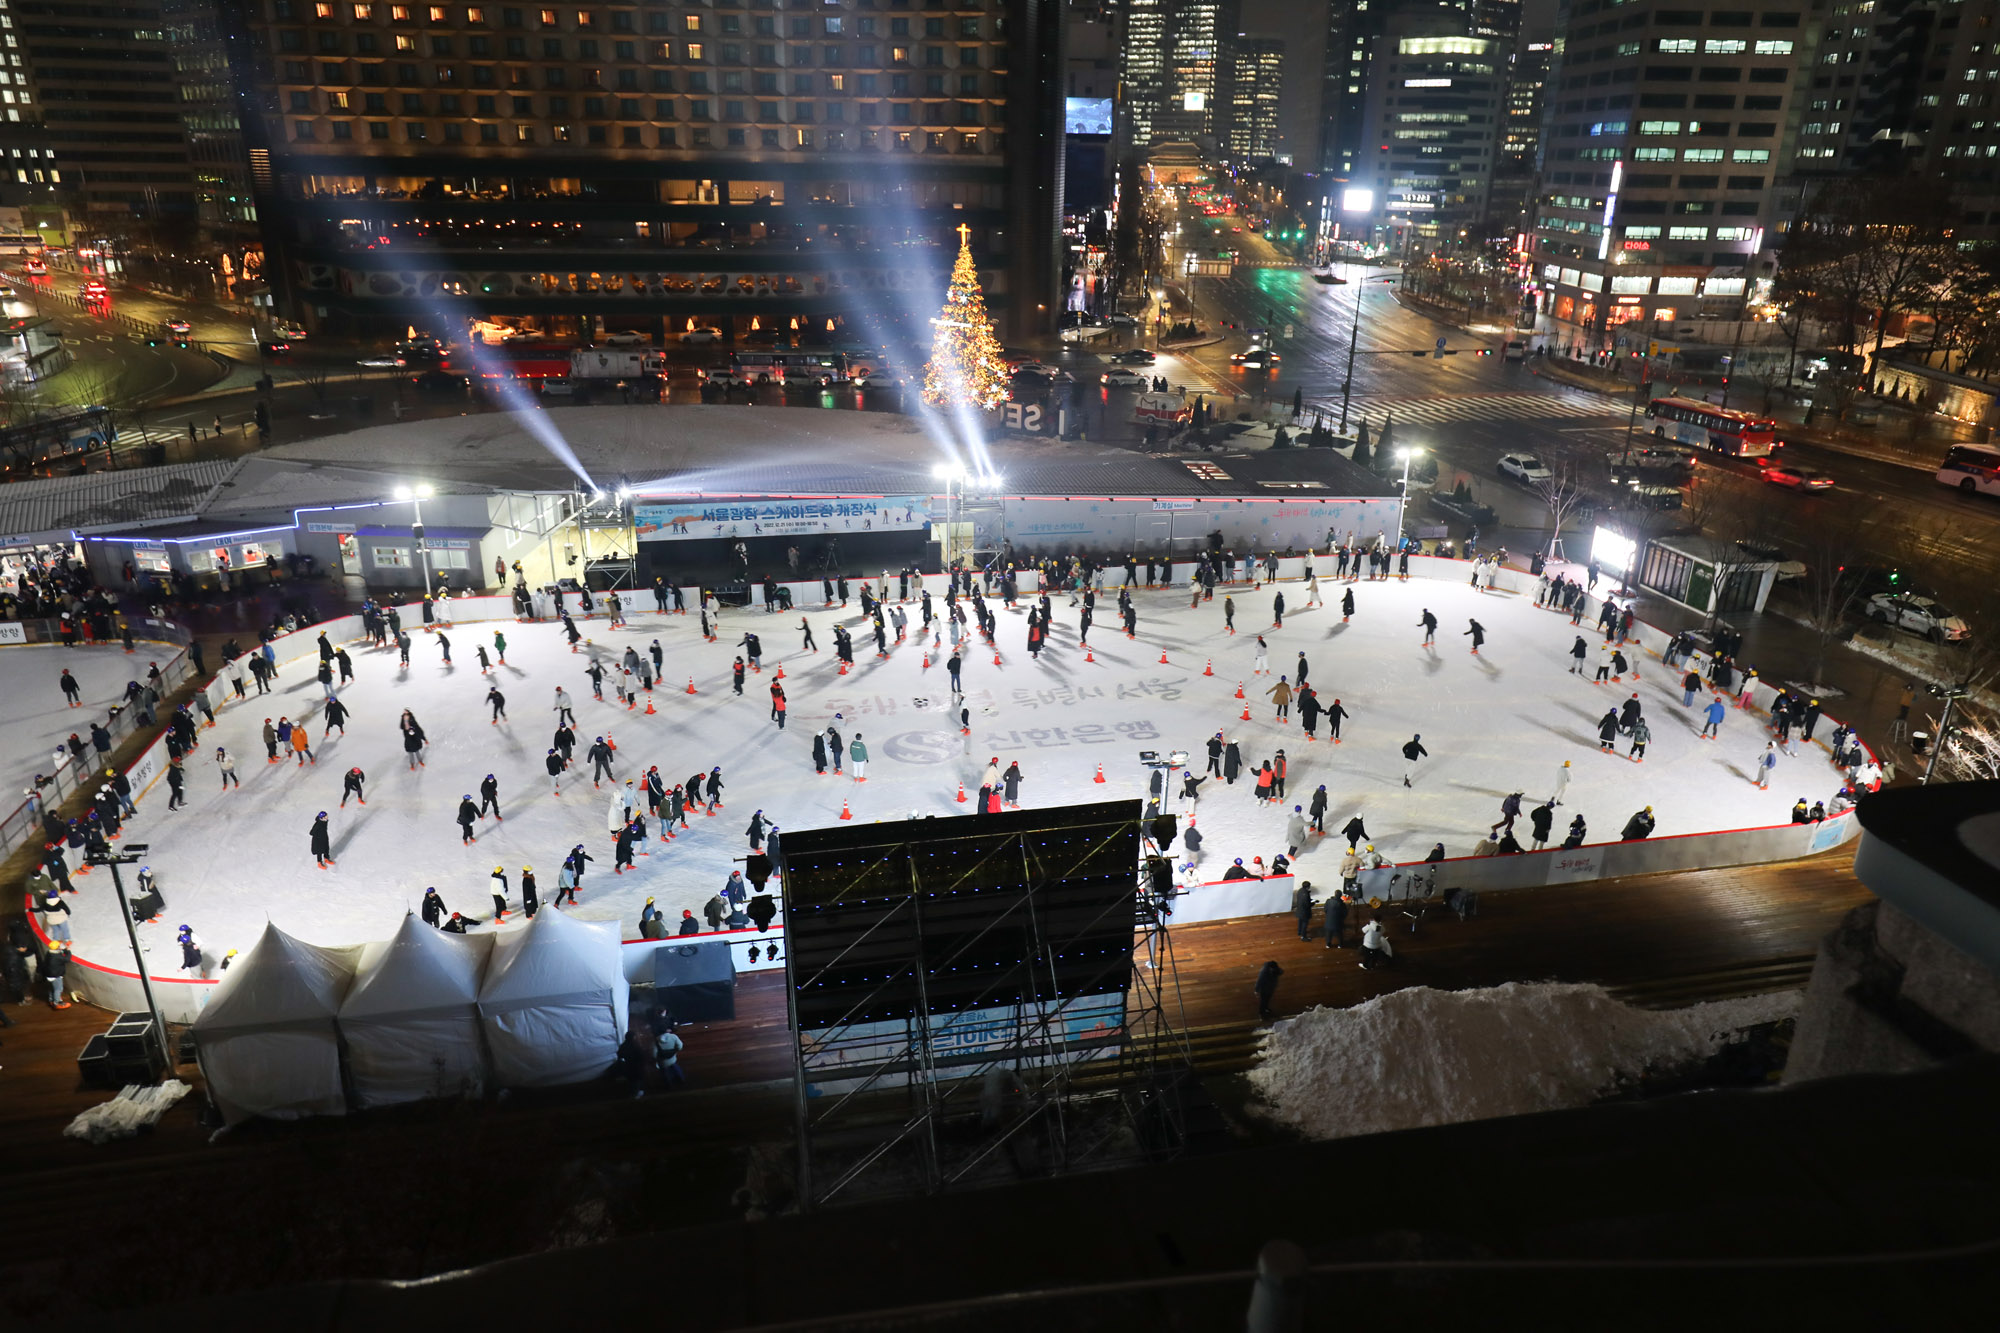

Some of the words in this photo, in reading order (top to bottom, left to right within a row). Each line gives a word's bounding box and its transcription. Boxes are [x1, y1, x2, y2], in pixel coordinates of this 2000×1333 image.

[1624, 241, 1650, 251] 다이소
[702, 507, 758, 522] 서울광장
[761, 504, 833, 520] 스케이트장
[836, 502, 877, 517] 개장식
[1154, 502, 1173, 510] 기계실
[1012, 686, 1104, 709] 특별시
[1116, 677, 1188, 701] 서울
[981, 719, 1161, 751] 신한은행
